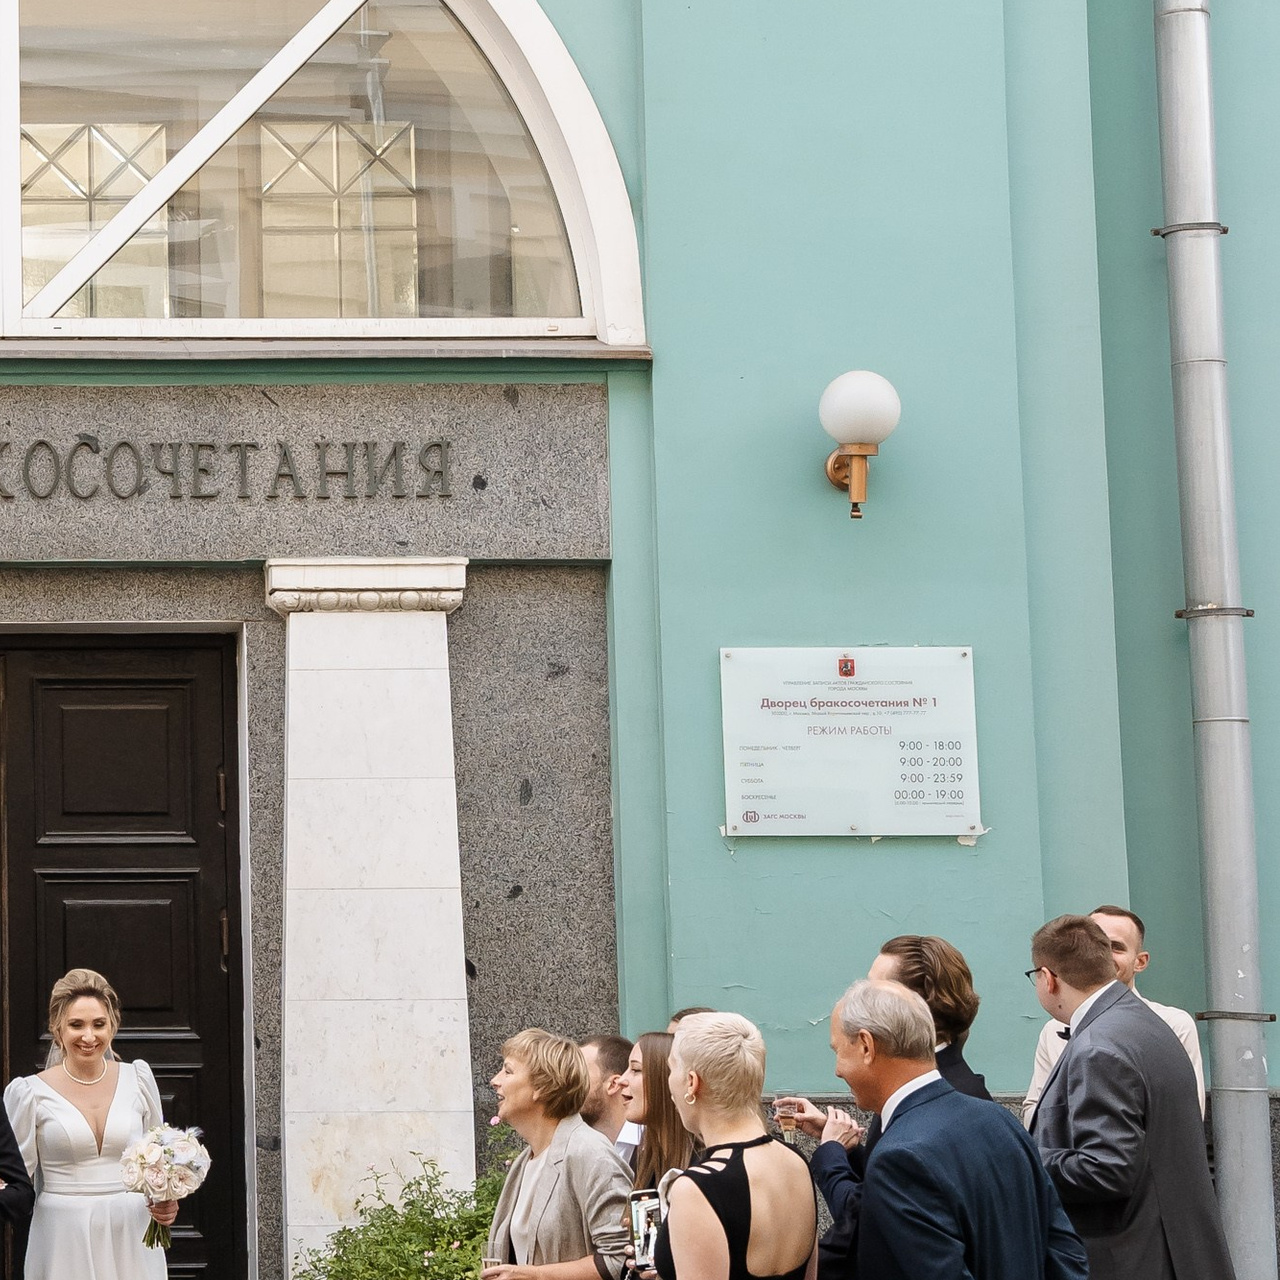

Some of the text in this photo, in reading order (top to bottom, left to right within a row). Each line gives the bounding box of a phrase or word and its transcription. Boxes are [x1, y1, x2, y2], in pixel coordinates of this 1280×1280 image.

[760, 698, 807, 710] Дворец
[809, 697, 909, 710] бракосочетания
[932, 697, 937, 707] 1
[807, 726, 892, 735] РЕЖИМ РАБОТЫ
[899, 740, 923, 750] 9:00
[934, 740, 962, 750] 18:00
[900, 757, 924, 766] 9:00
[932, 757, 962, 766] 20:00
[900, 773, 924, 783] 9:00
[933, 773, 963, 783] 23:59
[894, 790, 925, 799] 00:00
[935, 790, 964, 799] 19:00
